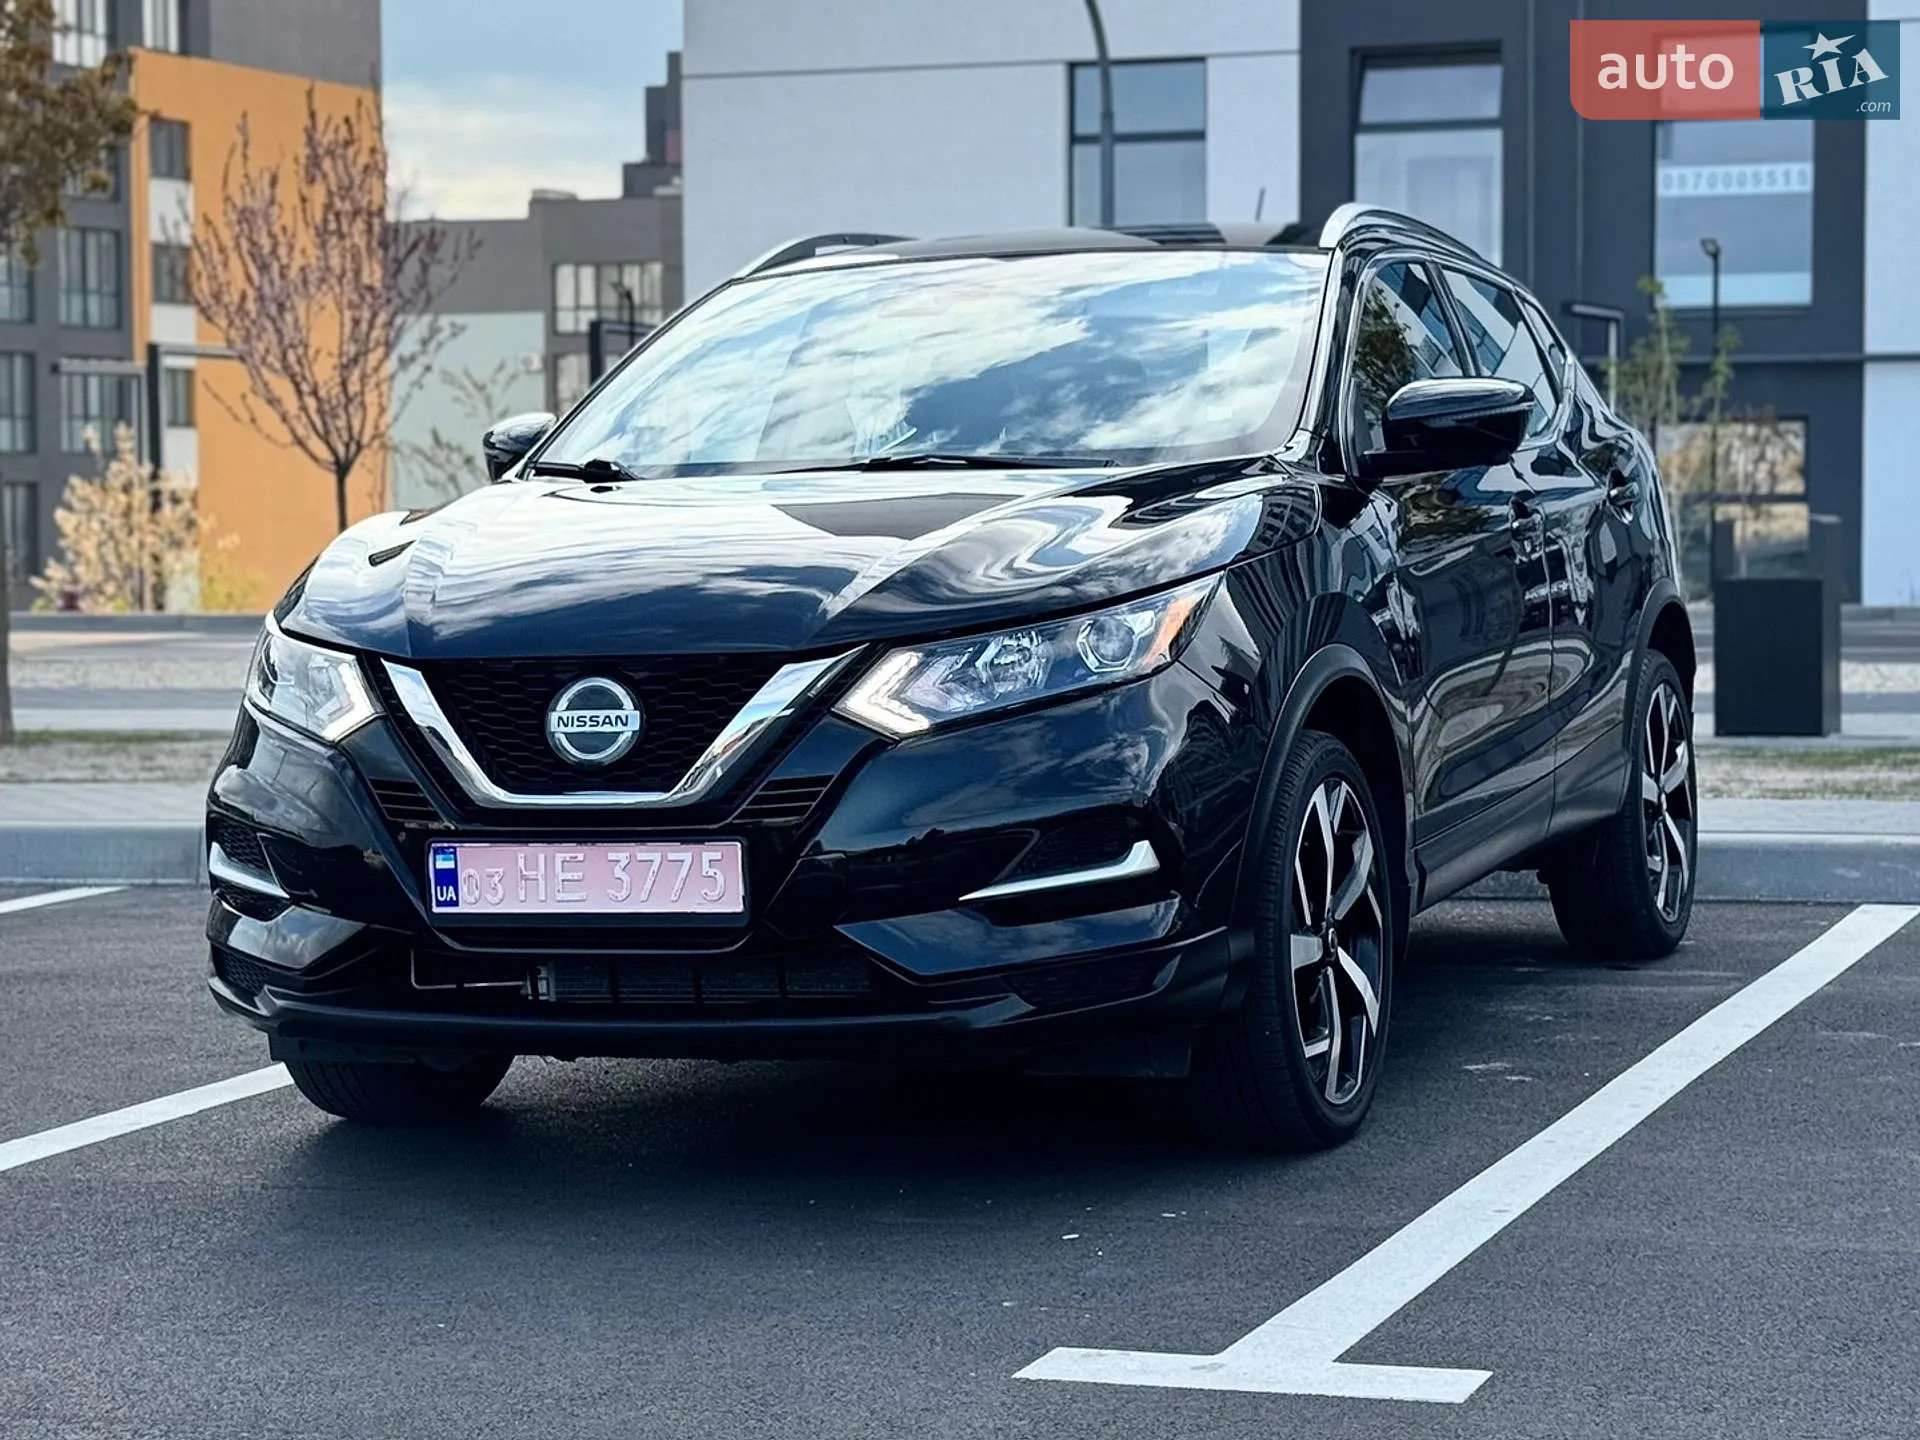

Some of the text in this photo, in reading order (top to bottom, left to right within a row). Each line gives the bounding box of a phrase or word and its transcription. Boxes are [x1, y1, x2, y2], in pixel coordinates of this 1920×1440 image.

[557, 715, 629, 728] NISSAN
[462, 852, 726, 904] 03 HE 3775
[437, 885, 456, 901] UA
